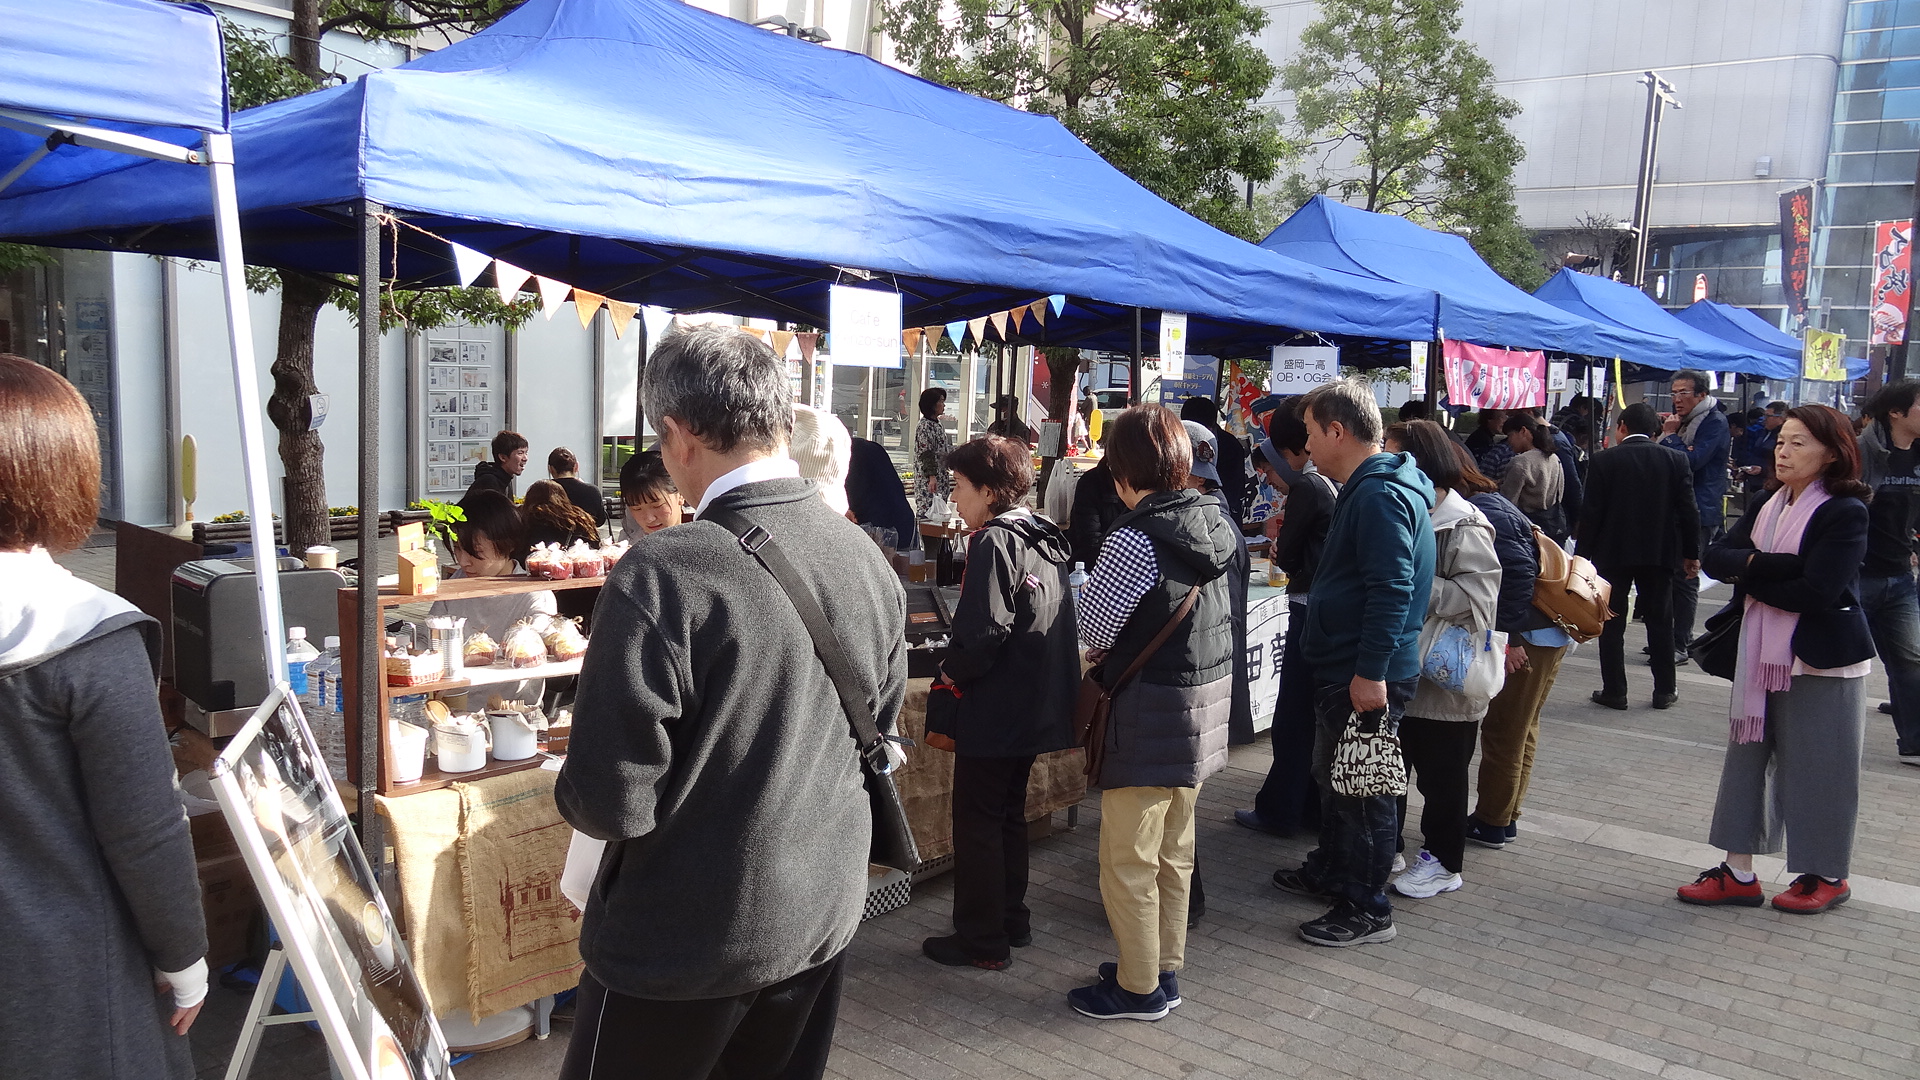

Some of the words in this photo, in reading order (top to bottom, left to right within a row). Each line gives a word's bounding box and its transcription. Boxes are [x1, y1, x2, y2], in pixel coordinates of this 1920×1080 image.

[850, 309, 880, 327] Cafe
[833, 332, 898, 348] nzo-sun
[1283, 358, 1326, 371] 盛岡一高
